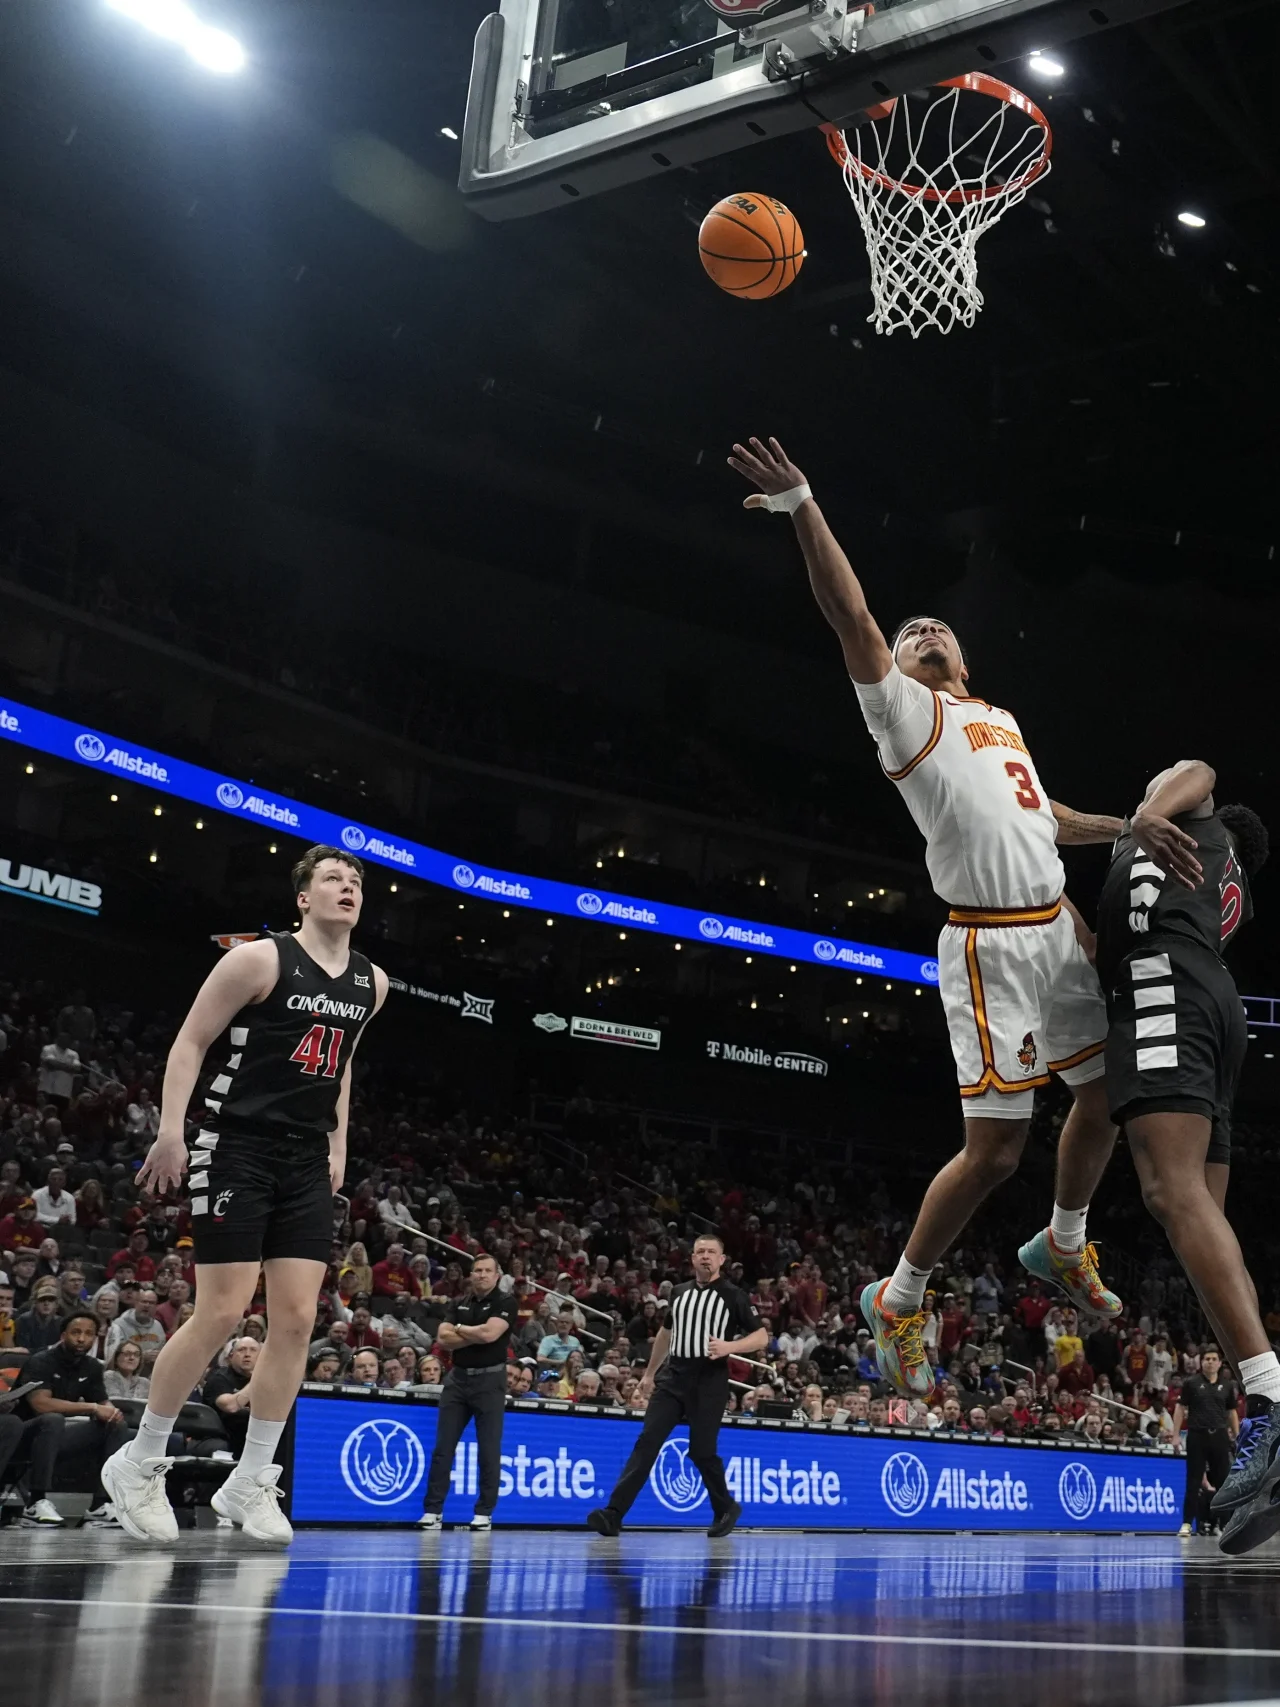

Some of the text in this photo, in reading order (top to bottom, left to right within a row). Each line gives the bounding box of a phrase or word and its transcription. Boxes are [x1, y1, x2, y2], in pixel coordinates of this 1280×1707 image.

[104, 748, 165, 782] Allstate
[1004, 761, 1041, 810] 3
[242, 796, 299, 828] Allstate
[364, 838, 415, 866] Allstate
[0, 859, 102, 909] UMB
[473, 875, 530, 899] Allstate
[601, 901, 656, 924] Allstate
[722, 925, 775, 947] Allstate
[835, 948, 884, 969] Allstate
[286, 991, 367, 1021] CINCINNATI
[417, 987, 440, 1001] Home
[441, 994, 450, 1004] of
[579, 1021, 605, 1033] BORN
[614, 1027, 654, 1040] BREWED
[289, 1024, 345, 1078] 41
[722, 1043, 772, 1066] Mobile
[774, 1056, 823, 1075] CENTER
[725, 1456, 841, 1506] Allstate
[931, 1467, 1028, 1511] Allstate
[1098, 1476, 1175, 1514] Allstate
